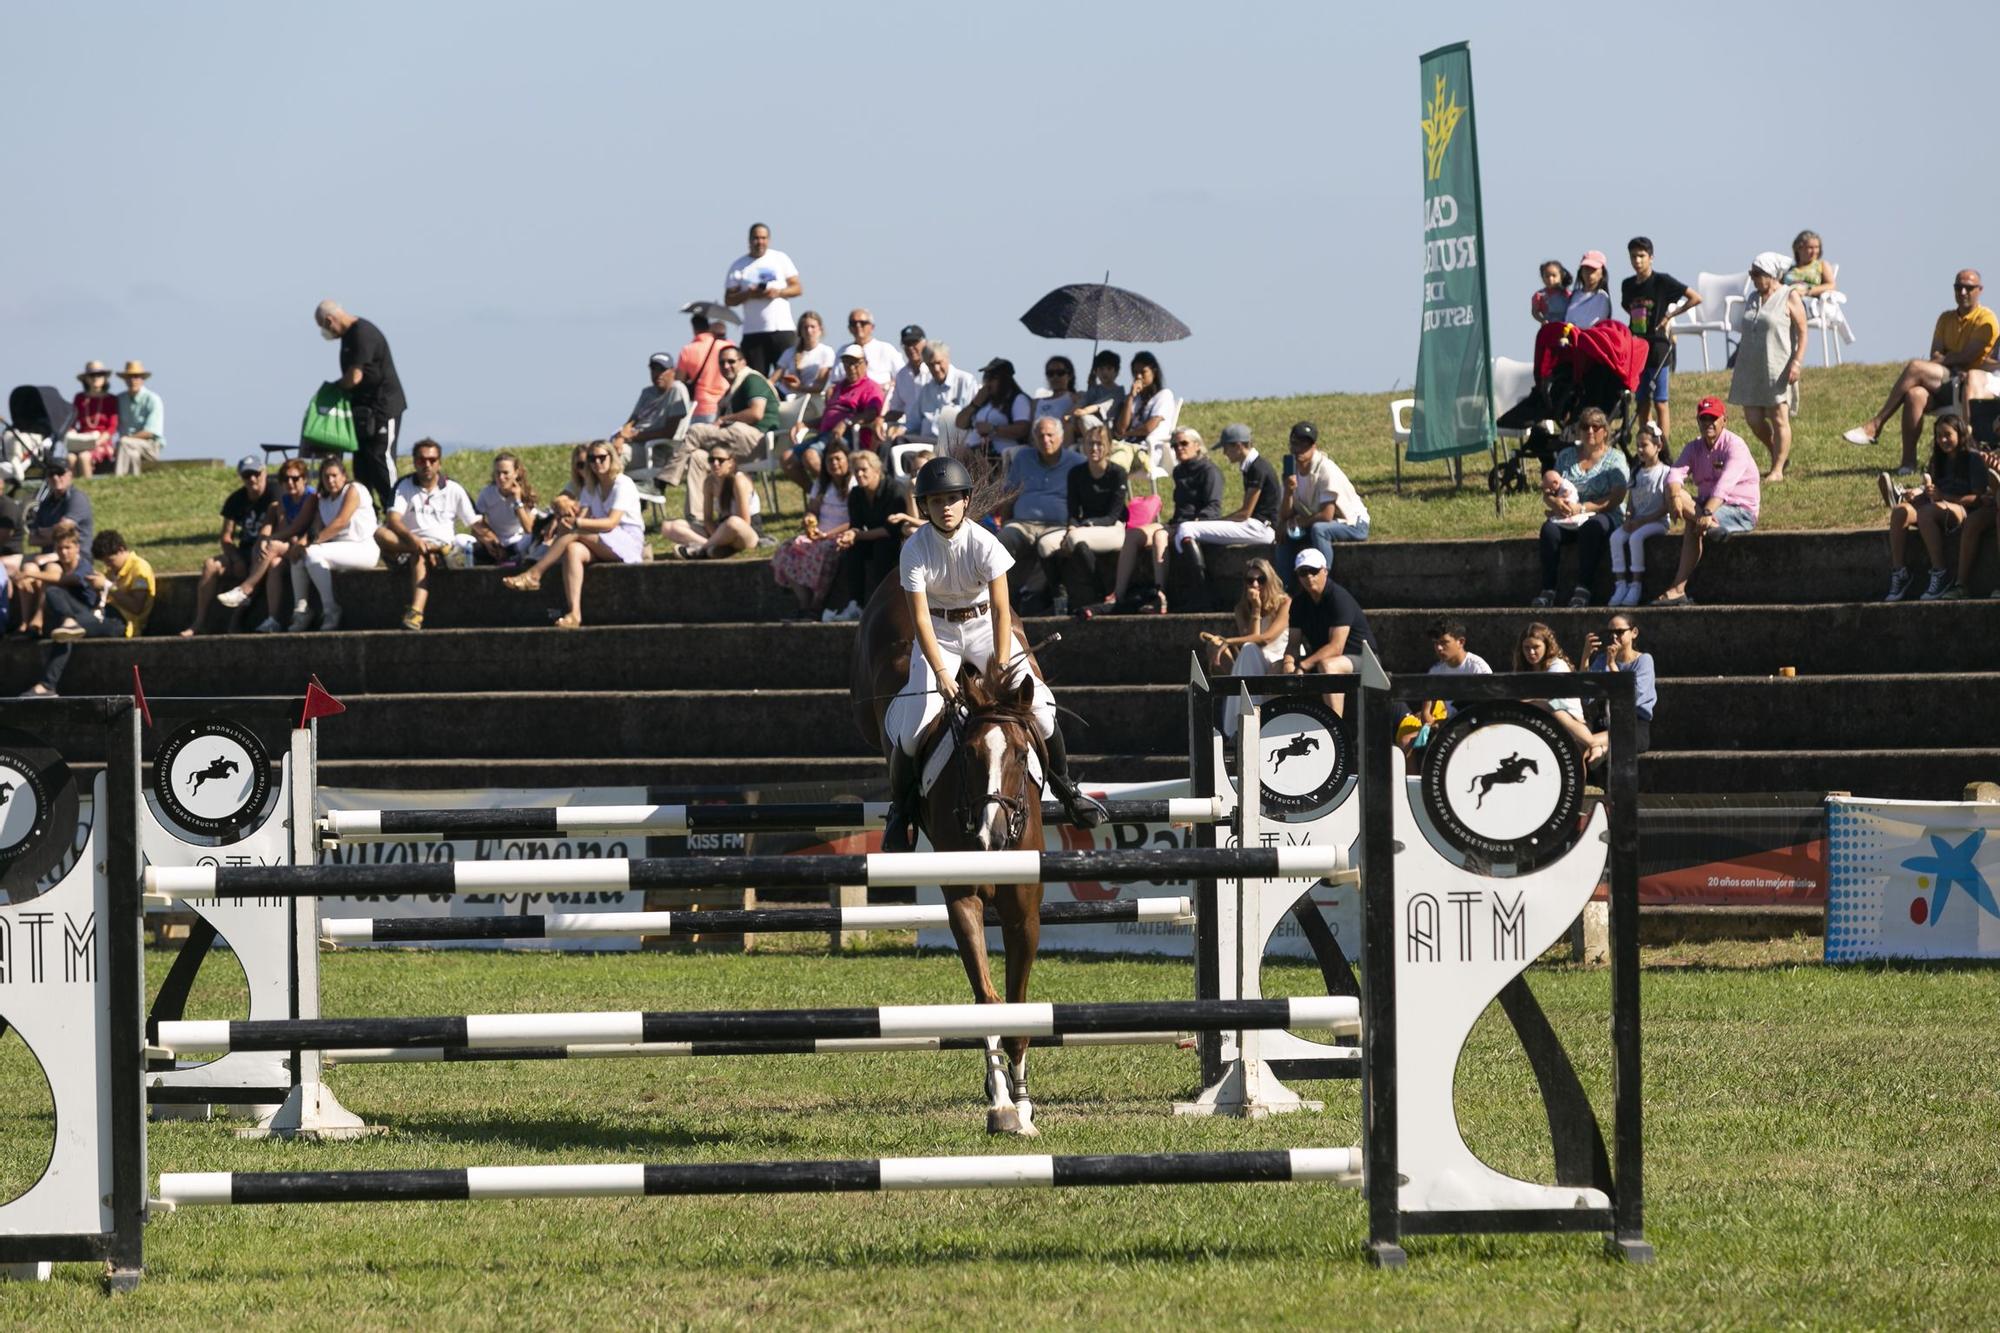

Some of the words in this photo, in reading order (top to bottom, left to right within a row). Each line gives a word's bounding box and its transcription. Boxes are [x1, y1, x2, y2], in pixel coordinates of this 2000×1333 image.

[687, 833, 720, 850] KISS
[722, 832, 744, 849] FM
[1707, 876, 1719, 887] 20
[1719, 876, 1740, 888] años
[1740, 879, 1756, 887] con
[1756, 877, 1764, 888] la
[1765, 877, 1788, 890] mejor
[1407, 891, 1526, 962] ATM
